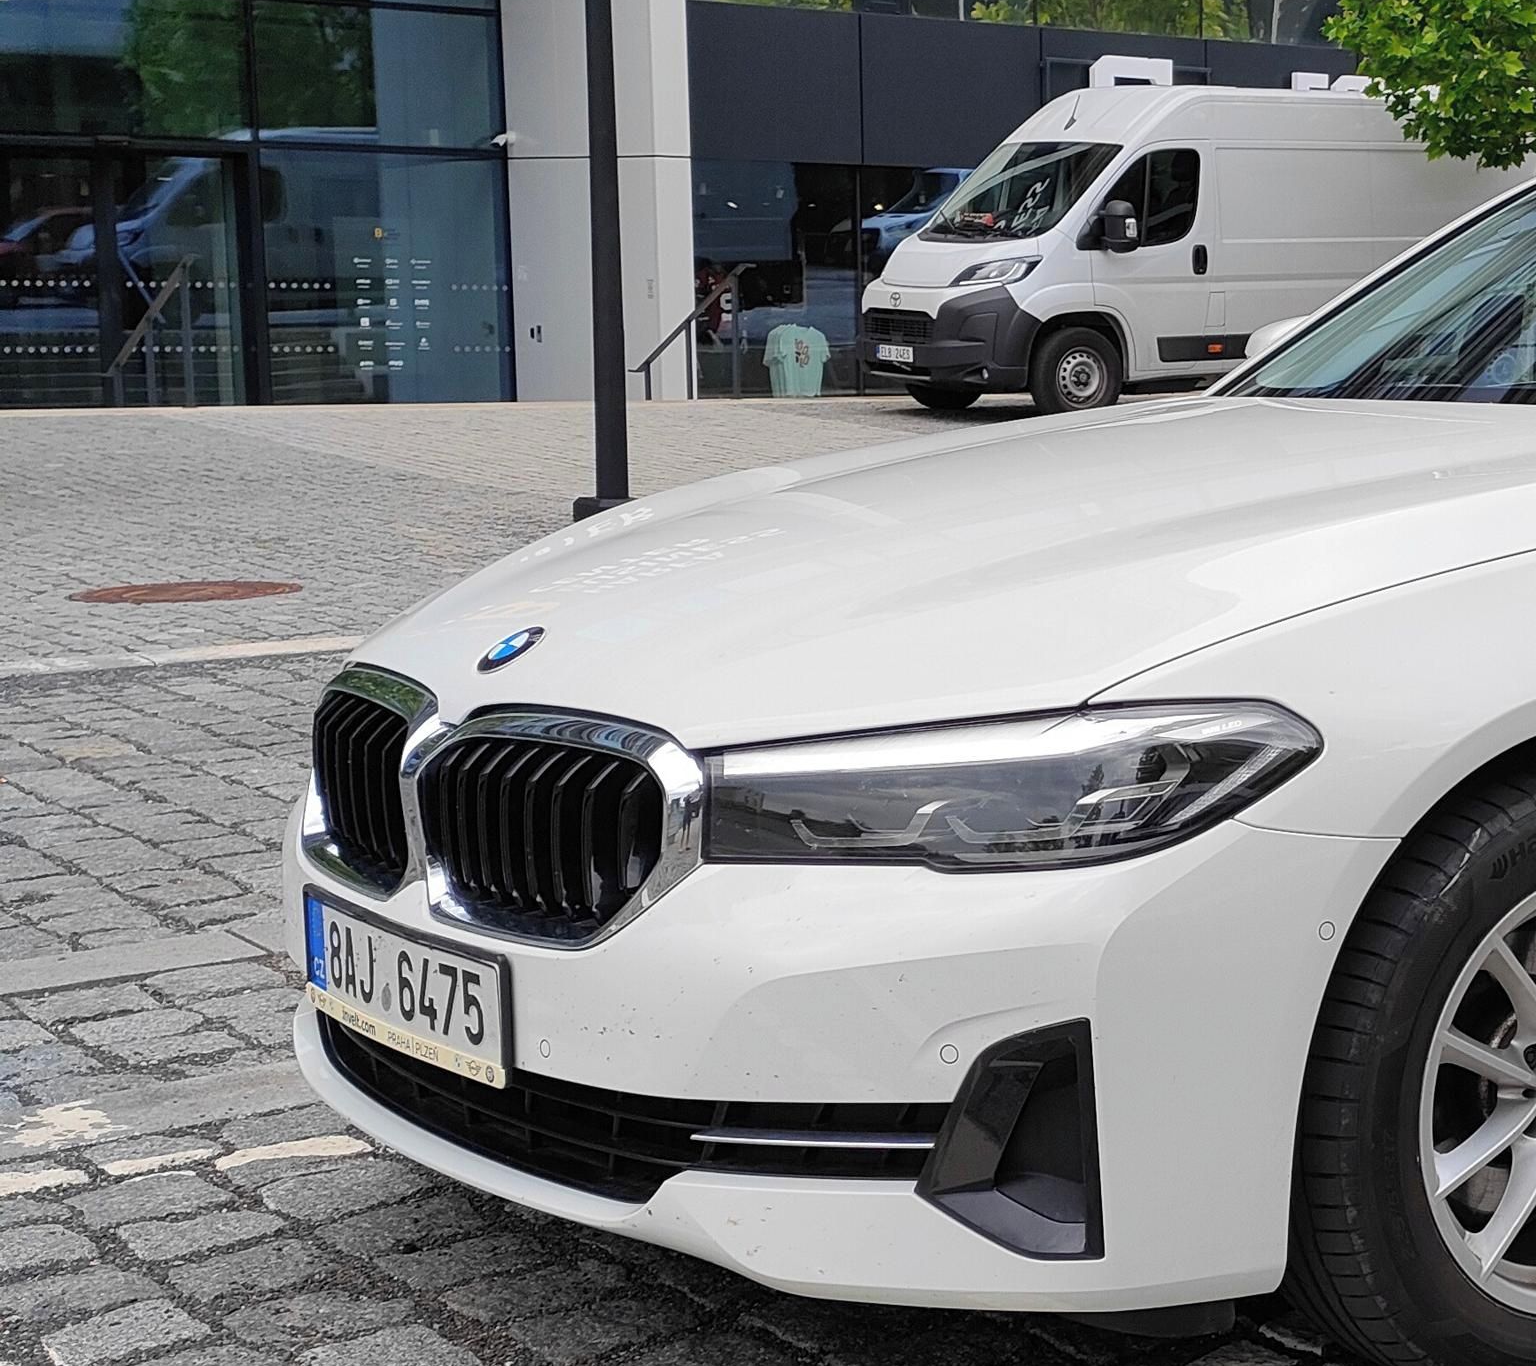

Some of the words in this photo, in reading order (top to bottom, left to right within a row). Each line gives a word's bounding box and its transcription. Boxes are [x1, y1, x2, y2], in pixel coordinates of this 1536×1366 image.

[313, 956, 326, 980] CZ
[329, 920, 375, 1004] 8AJ
[397, 950, 485, 1046] 6475
